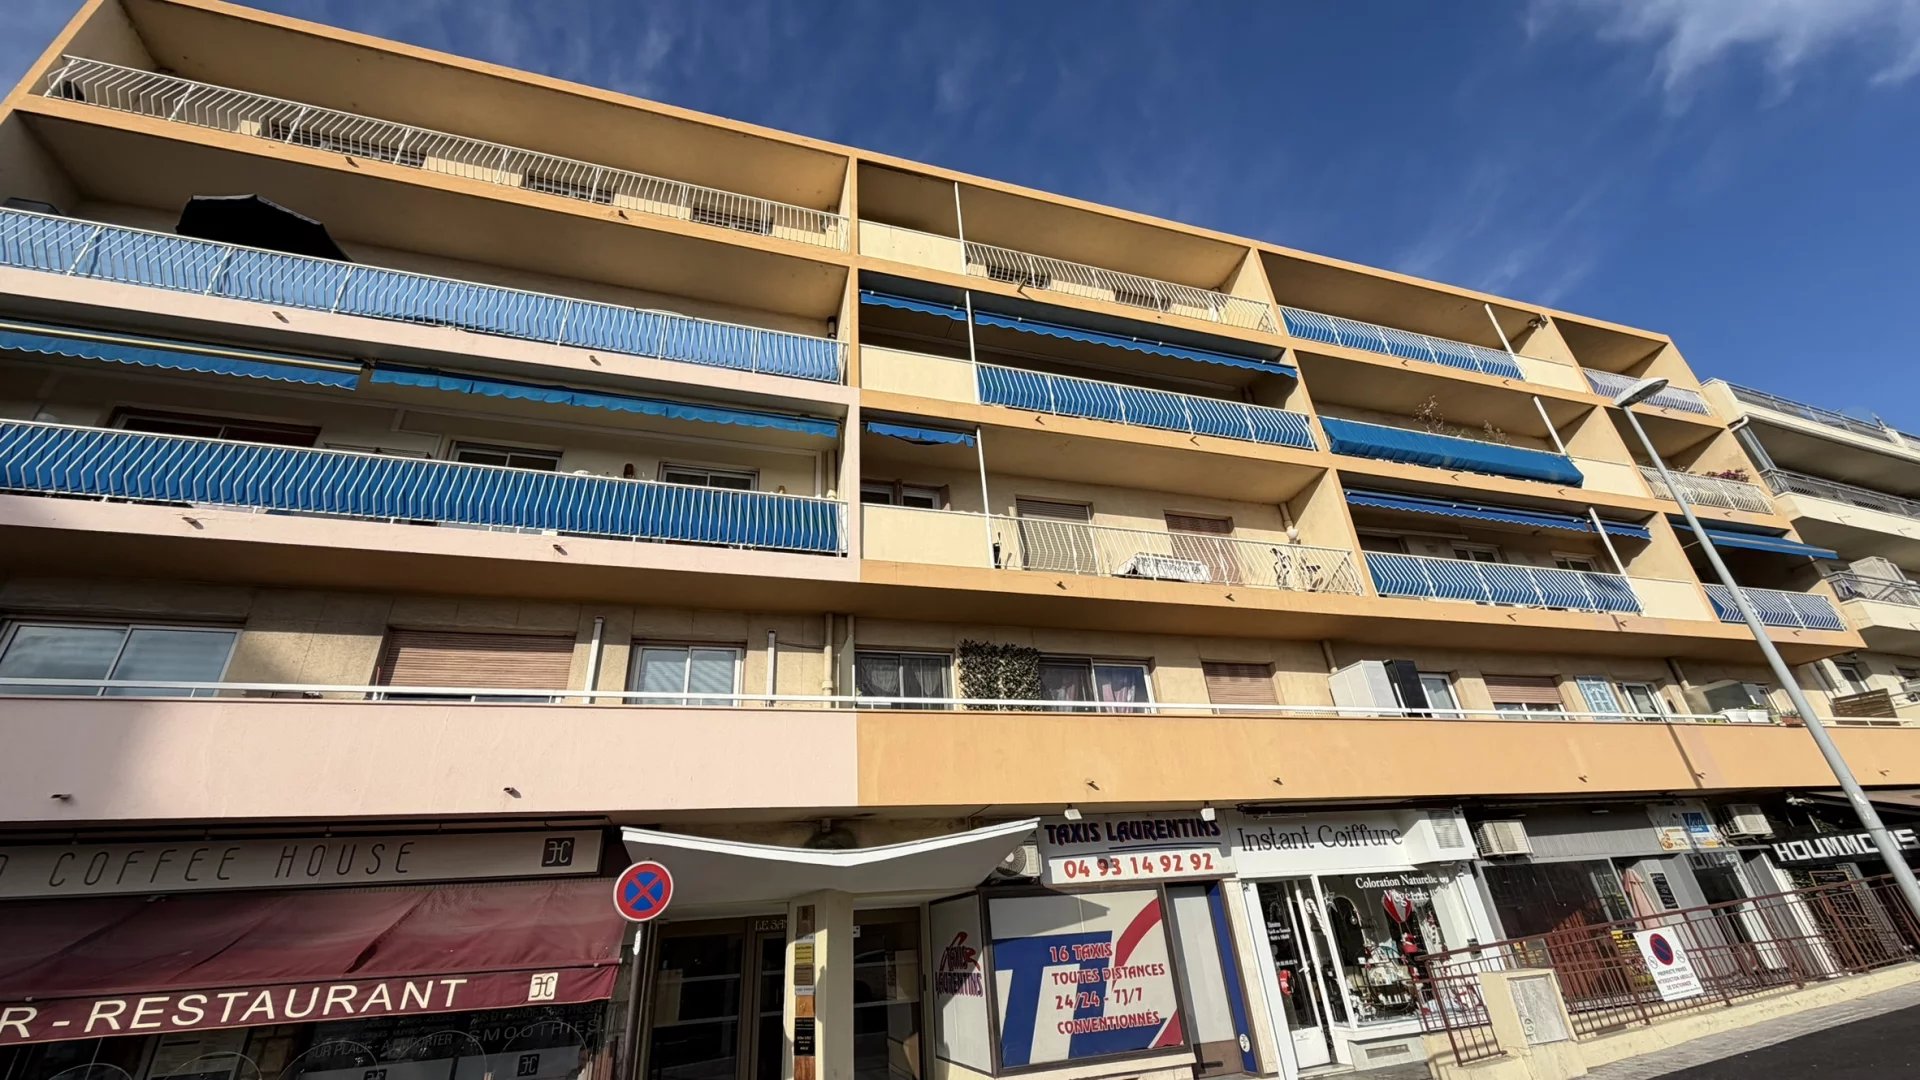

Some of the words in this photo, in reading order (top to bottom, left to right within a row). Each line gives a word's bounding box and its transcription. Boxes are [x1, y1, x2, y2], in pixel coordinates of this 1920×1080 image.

[1044, 822, 1101, 846] TAXIS
[1105, 818, 1222, 842] LAURENTINS
[1237, 826, 1315, 852] Instant
[1317, 823, 1403, 848] Coiffure
[1771, 828, 1920, 862] HOUMMOS
[49, 847, 240, 887] COFFEE
[274, 841, 415, 879] HOUSE
[1063, 859, 1091, 879] 04
[1097, 857, 1122, 876] 93
[1129, 855, 1154, 875] 14
[1159, 854, 1184, 873] 92
[1189, 853, 1214, 871] 92
[1355, 875, 1400, 889] Coloration
[1049, 945, 1069, 962] 16
[1072, 942, 1113, 961] TAXIS
[1051, 968, 1100, 985] TOUTES
[1102, 963, 1165, 981] DISTANCES
[84, 979, 467, 1033] RESTAURANT
[1055, 991, 1100, 1011] 24/24
[467, 1019, 599, 1042] SMOOTHIES
[1057, 1008, 1161, 1035] CONVENTIONNÉS
